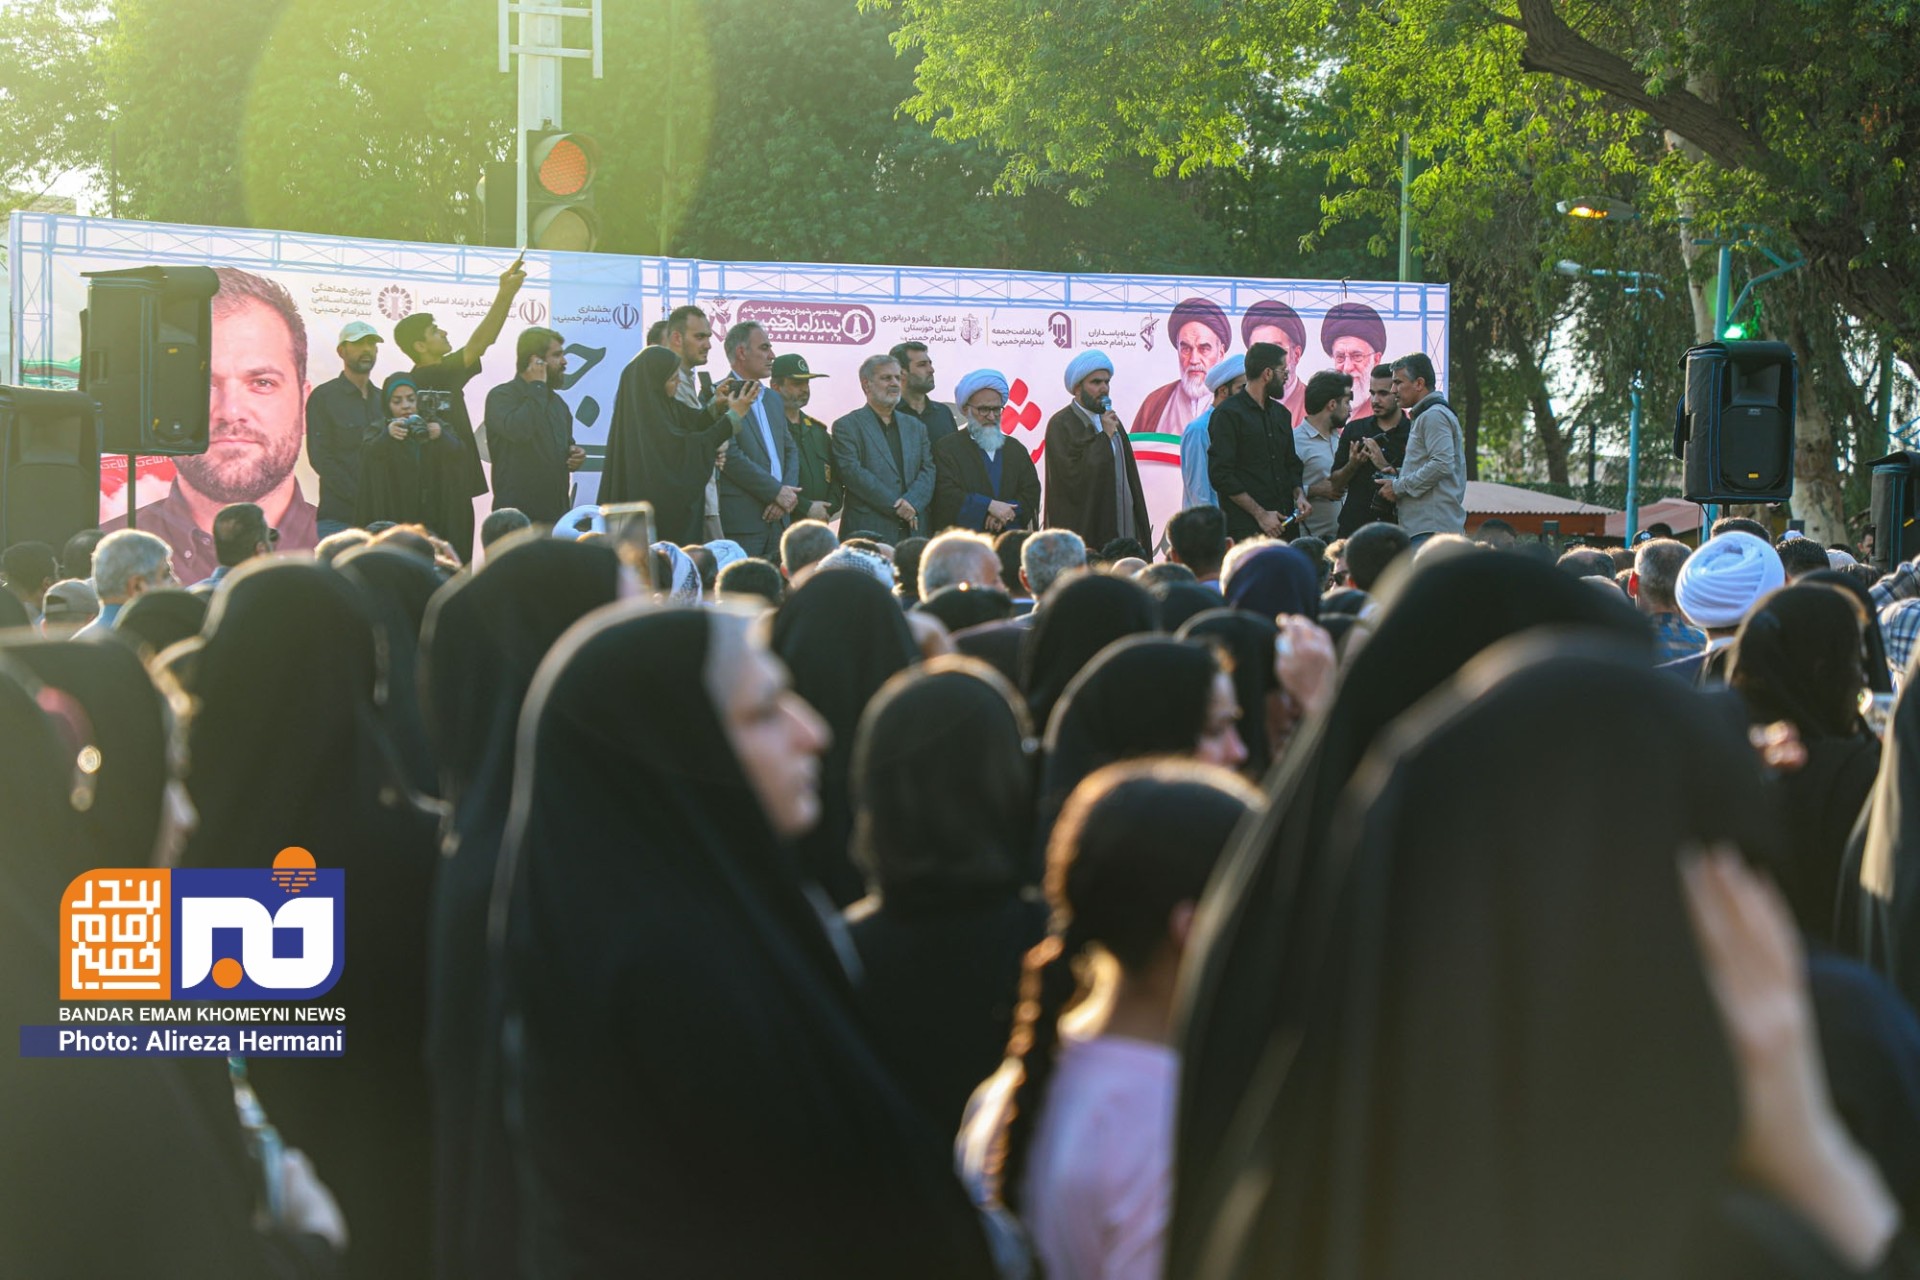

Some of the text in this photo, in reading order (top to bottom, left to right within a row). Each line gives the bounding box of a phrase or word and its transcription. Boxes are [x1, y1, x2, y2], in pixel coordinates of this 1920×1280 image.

[311, 295, 343, 304] اسلامی
[422, 296, 449, 306] اسلامی
[450, 297, 469, 307] ارشاد
[578, 304, 612, 314] بخشداری
[880, 314, 911, 323] دریانوردی
[916, 315, 931, 324] بنادر
[931, 314, 942, 324] کل
[942, 315, 957, 324] اداره
[904, 324, 955, 333] استان خوزستان
[1088, 328, 1137, 339] سپاه پاسداران
